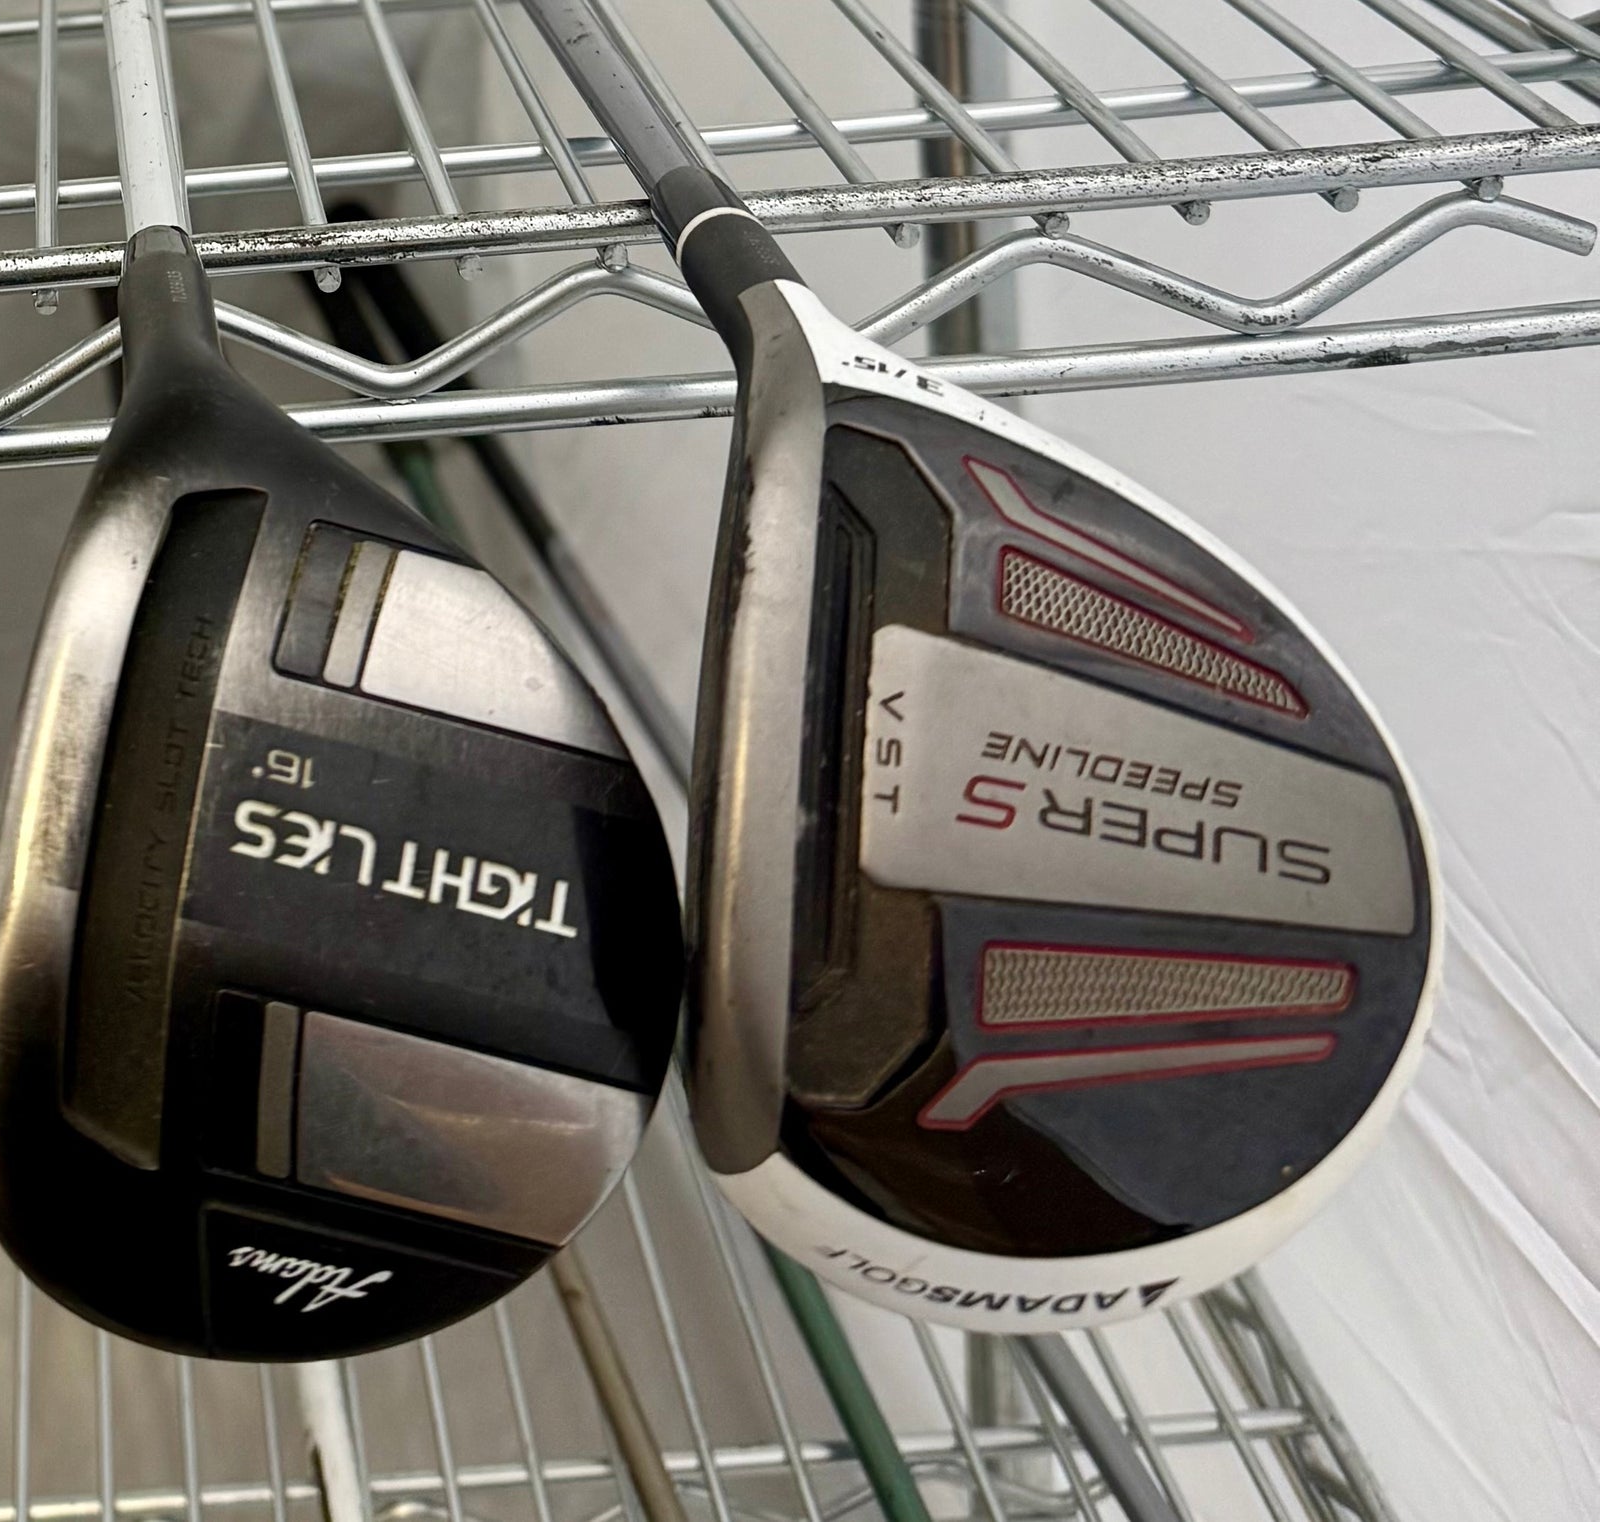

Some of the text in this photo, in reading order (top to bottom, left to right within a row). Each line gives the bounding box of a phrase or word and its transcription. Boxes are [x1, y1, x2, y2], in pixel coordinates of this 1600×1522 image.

[156, 720, 188, 813] SLOT
[175, 615, 213, 700] TECH
[981, 731, 1243, 807] SPEEDLINE
[229, 799, 577, 938] TIGHT LIES
[955, 775, 1332, 885] SUPER S
[228, 1246, 393, 1312] Adams
[814, 1245, 1129, 1313] ADAMSGOLF
